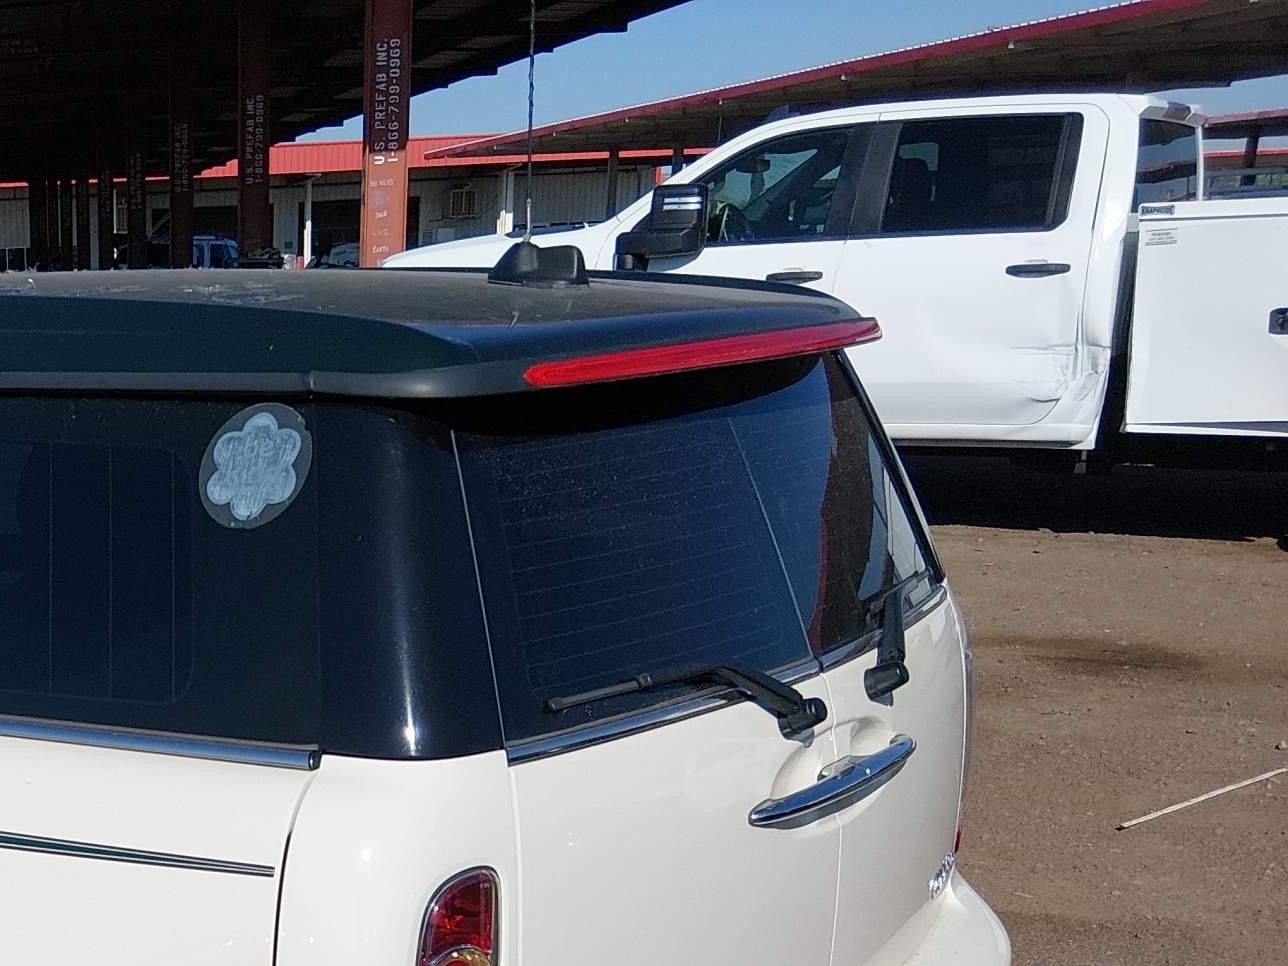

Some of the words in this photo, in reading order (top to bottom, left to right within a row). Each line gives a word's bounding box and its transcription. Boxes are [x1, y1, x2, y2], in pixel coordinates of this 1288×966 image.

[376, 37, 388, 65] INC.
[375, 73, 387, 129] PREFAB
[387, 38, 401, 162] 1-866-799-0969
[245, 119, 255, 160] PREFAB
[374, 137, 386, 165] U.S.
